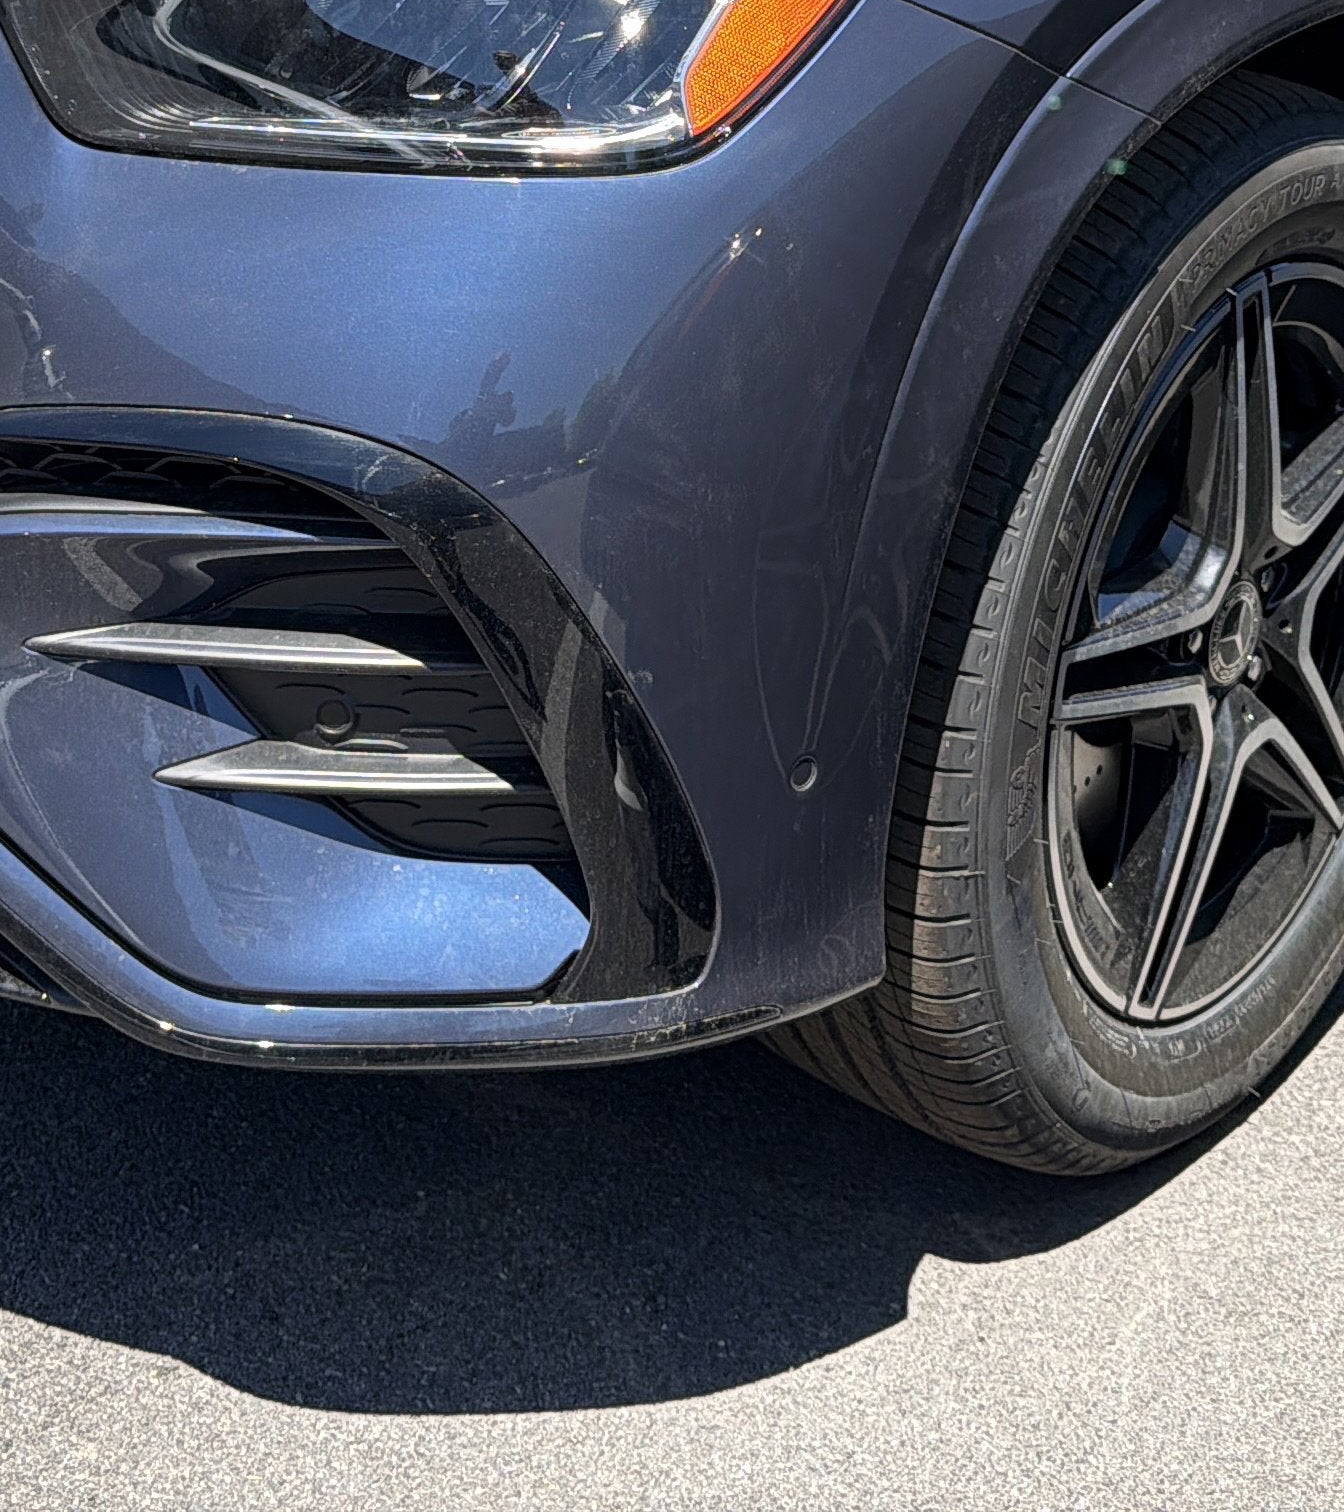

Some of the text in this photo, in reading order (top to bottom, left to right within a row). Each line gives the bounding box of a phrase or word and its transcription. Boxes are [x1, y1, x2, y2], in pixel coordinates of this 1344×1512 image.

[1188, 194, 1272, 285] PRIMACY
[1279, 174, 1327, 211] TOUR
[1016, 314, 1165, 730] MICHELIN
